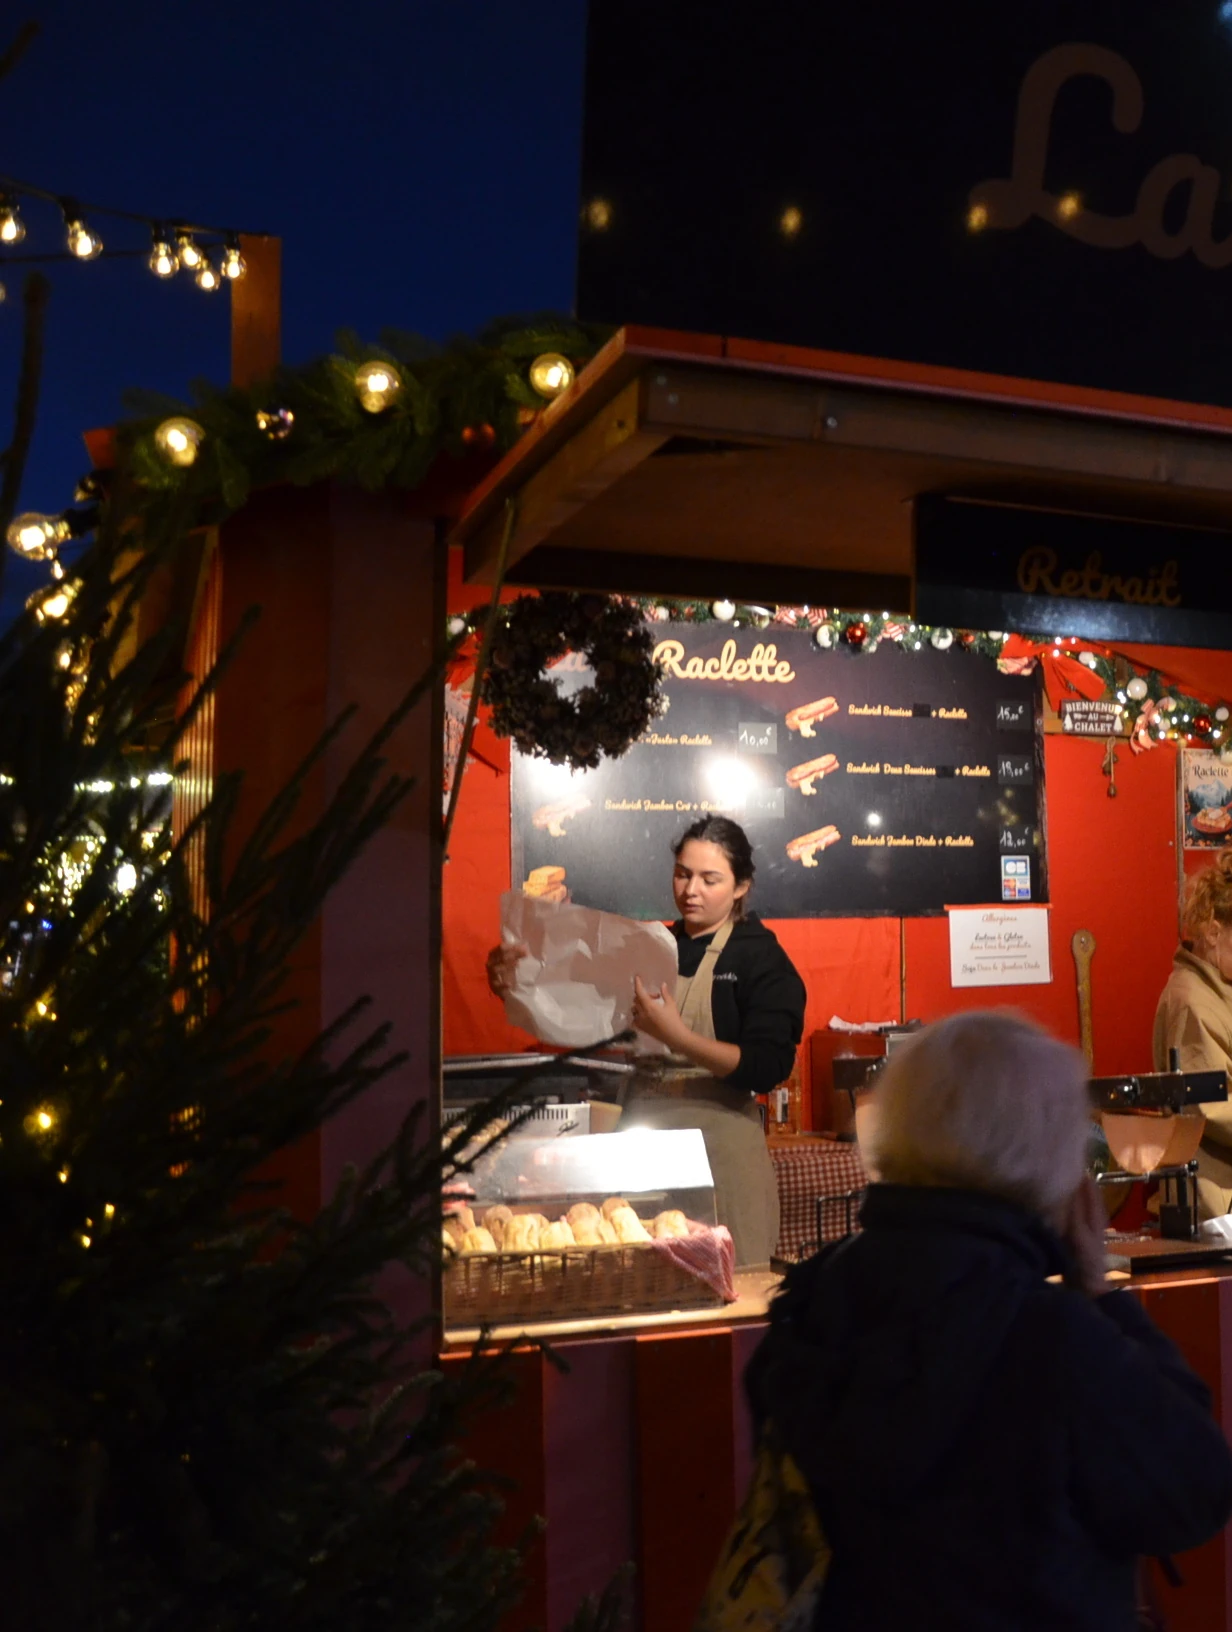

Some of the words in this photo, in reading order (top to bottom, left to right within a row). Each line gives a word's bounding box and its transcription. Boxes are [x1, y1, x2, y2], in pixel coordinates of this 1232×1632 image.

[1016, 544, 1183, 608] Retrait
[652, 639, 796, 683] Raclette
[848, 703, 882, 716] Sandwich
[938, 707, 968, 719] Raclette
[1065, 701, 1123, 715] BIENVENU
[1088, 712, 1099, 721] AU
[1074, 722, 1113, 733] CHALET
[846, 762, 880, 774] Sandwich
[961, 764, 991, 777] Raclette
[1192, 763, 1229, 779] Raclette
[604, 798, 642, 811] Sandwich
[851, 834, 885, 846] Sandwich
[944, 834, 974, 847] Raclette
